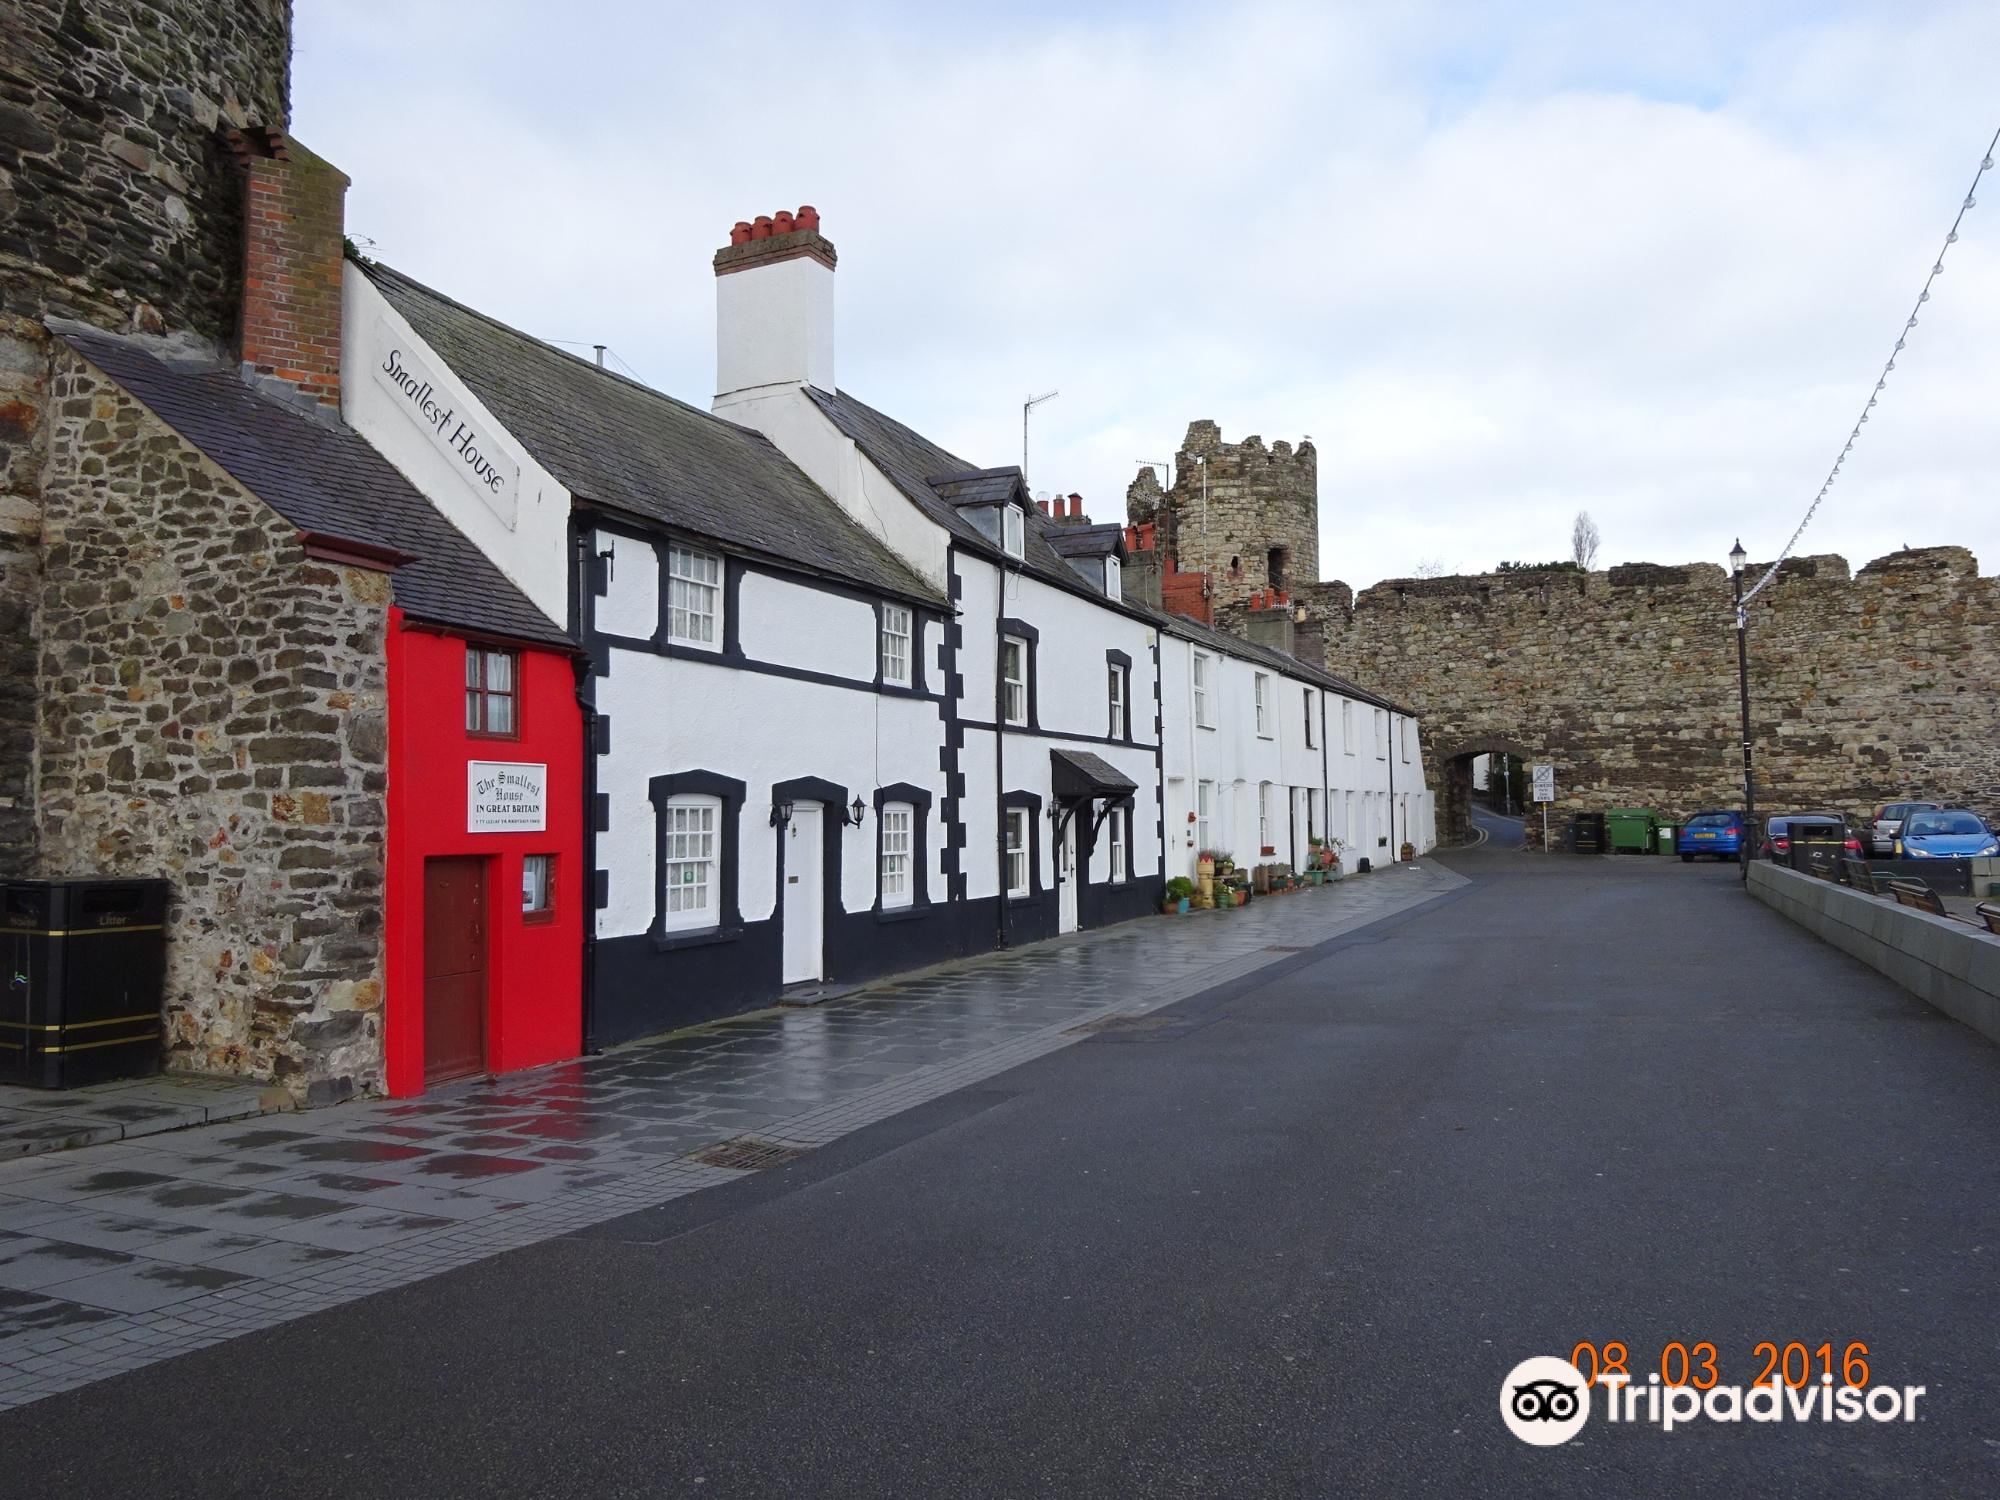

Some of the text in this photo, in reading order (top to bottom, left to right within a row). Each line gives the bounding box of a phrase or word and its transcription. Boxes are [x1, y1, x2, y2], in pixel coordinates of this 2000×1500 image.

[382, 349, 505, 493] Smallest House
[476, 771, 540, 797] The Smallest
[496, 787, 524, 801] House
[476, 805, 540, 813] IN GREAT BRITAIN
